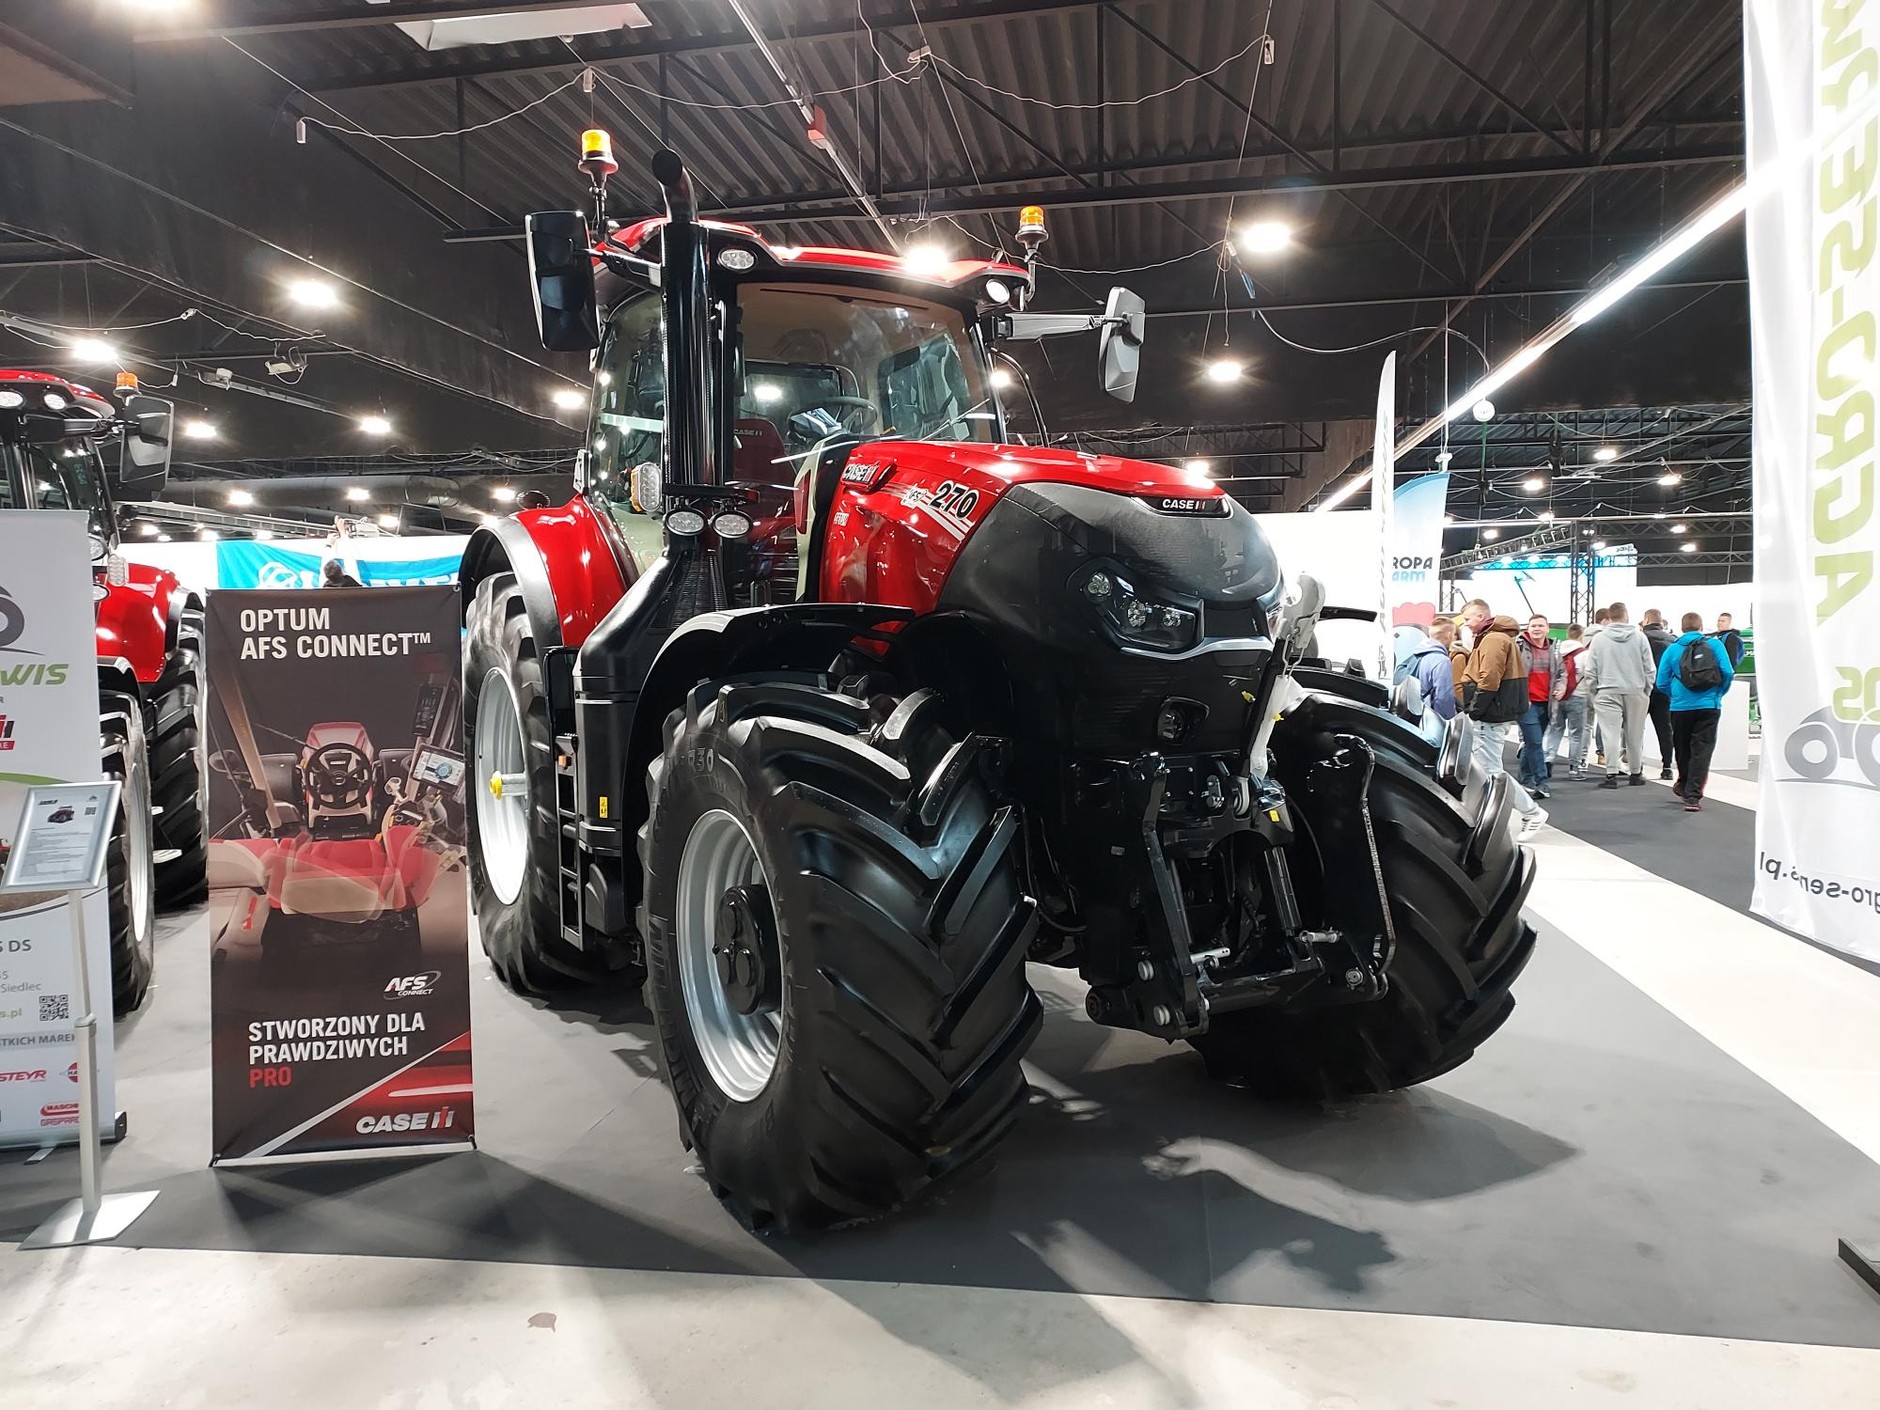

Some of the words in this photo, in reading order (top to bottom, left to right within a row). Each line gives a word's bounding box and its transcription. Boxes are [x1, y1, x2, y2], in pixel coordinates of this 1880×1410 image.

[929, 480, 978, 520] 270
[1162, 499, 1194, 509] CASE
[240, 607, 330, 632] OPTUM
[240, 636, 287, 659] AFS
[9, 939, 32, 952] DS
[1, 982, 41, 993] Siedlec
[384, 975, 428, 992] AFS
[398, 988, 434, 996] CONNECT
[249, 1015, 380, 1042] STWORZONY
[387, 1012, 425, 1032] DLA
[250, 1036, 407, 1065] PRAWDZIWYCH
[0, 1070, 47, 1082] STEYR
[250, 1067, 292, 1088] PRO
[356, 1113, 430, 1133] CASE
